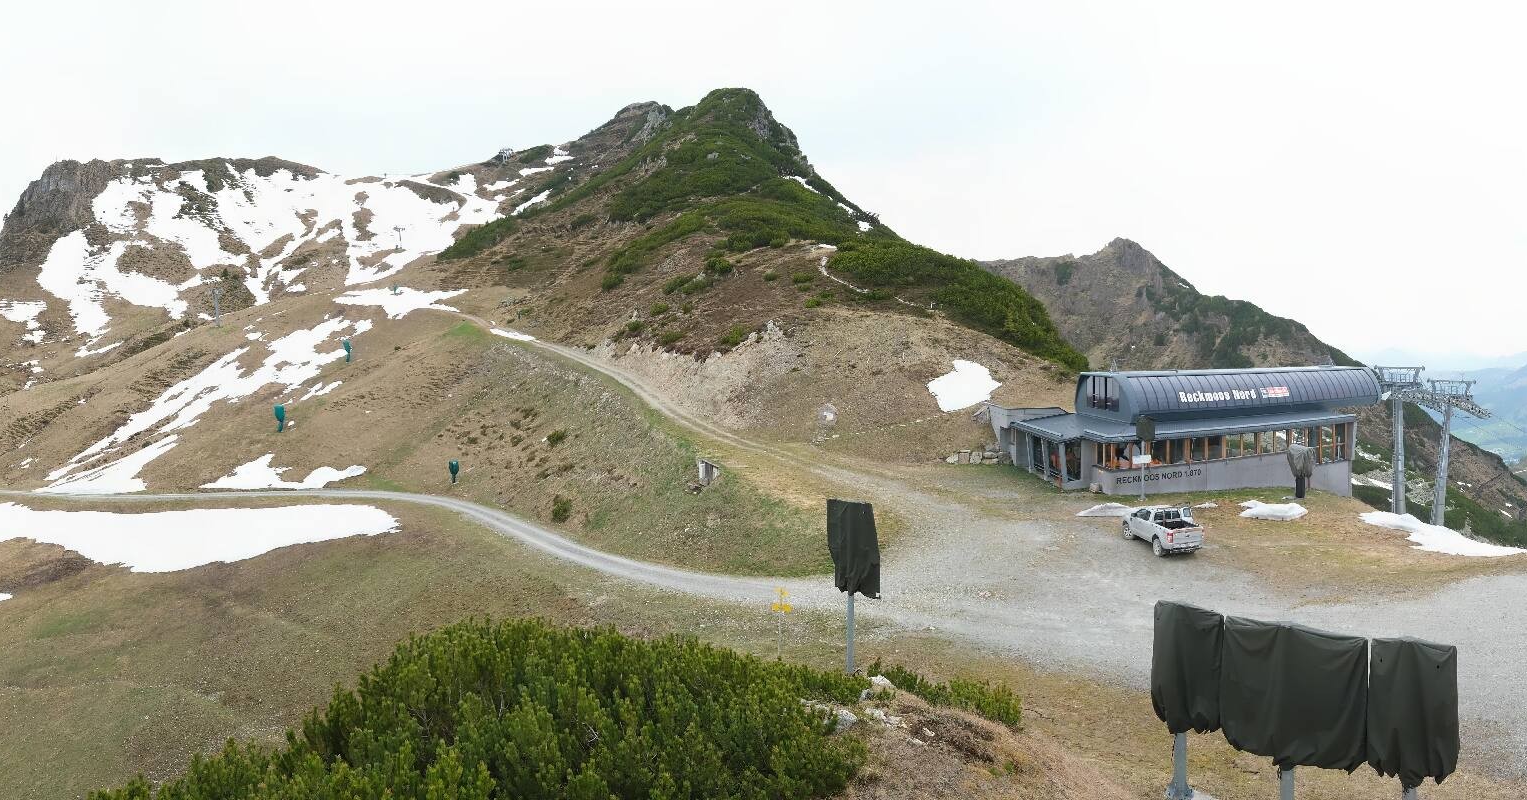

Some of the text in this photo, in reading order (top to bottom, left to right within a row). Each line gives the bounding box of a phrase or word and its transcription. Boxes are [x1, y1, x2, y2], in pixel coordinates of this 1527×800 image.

[1178, 391, 1230, 402] Reckmoos
[1232, 389, 1256, 400] Nord
[1161, 471, 1182, 480] NORD
[1185, 469, 1202, 477] 1.870
